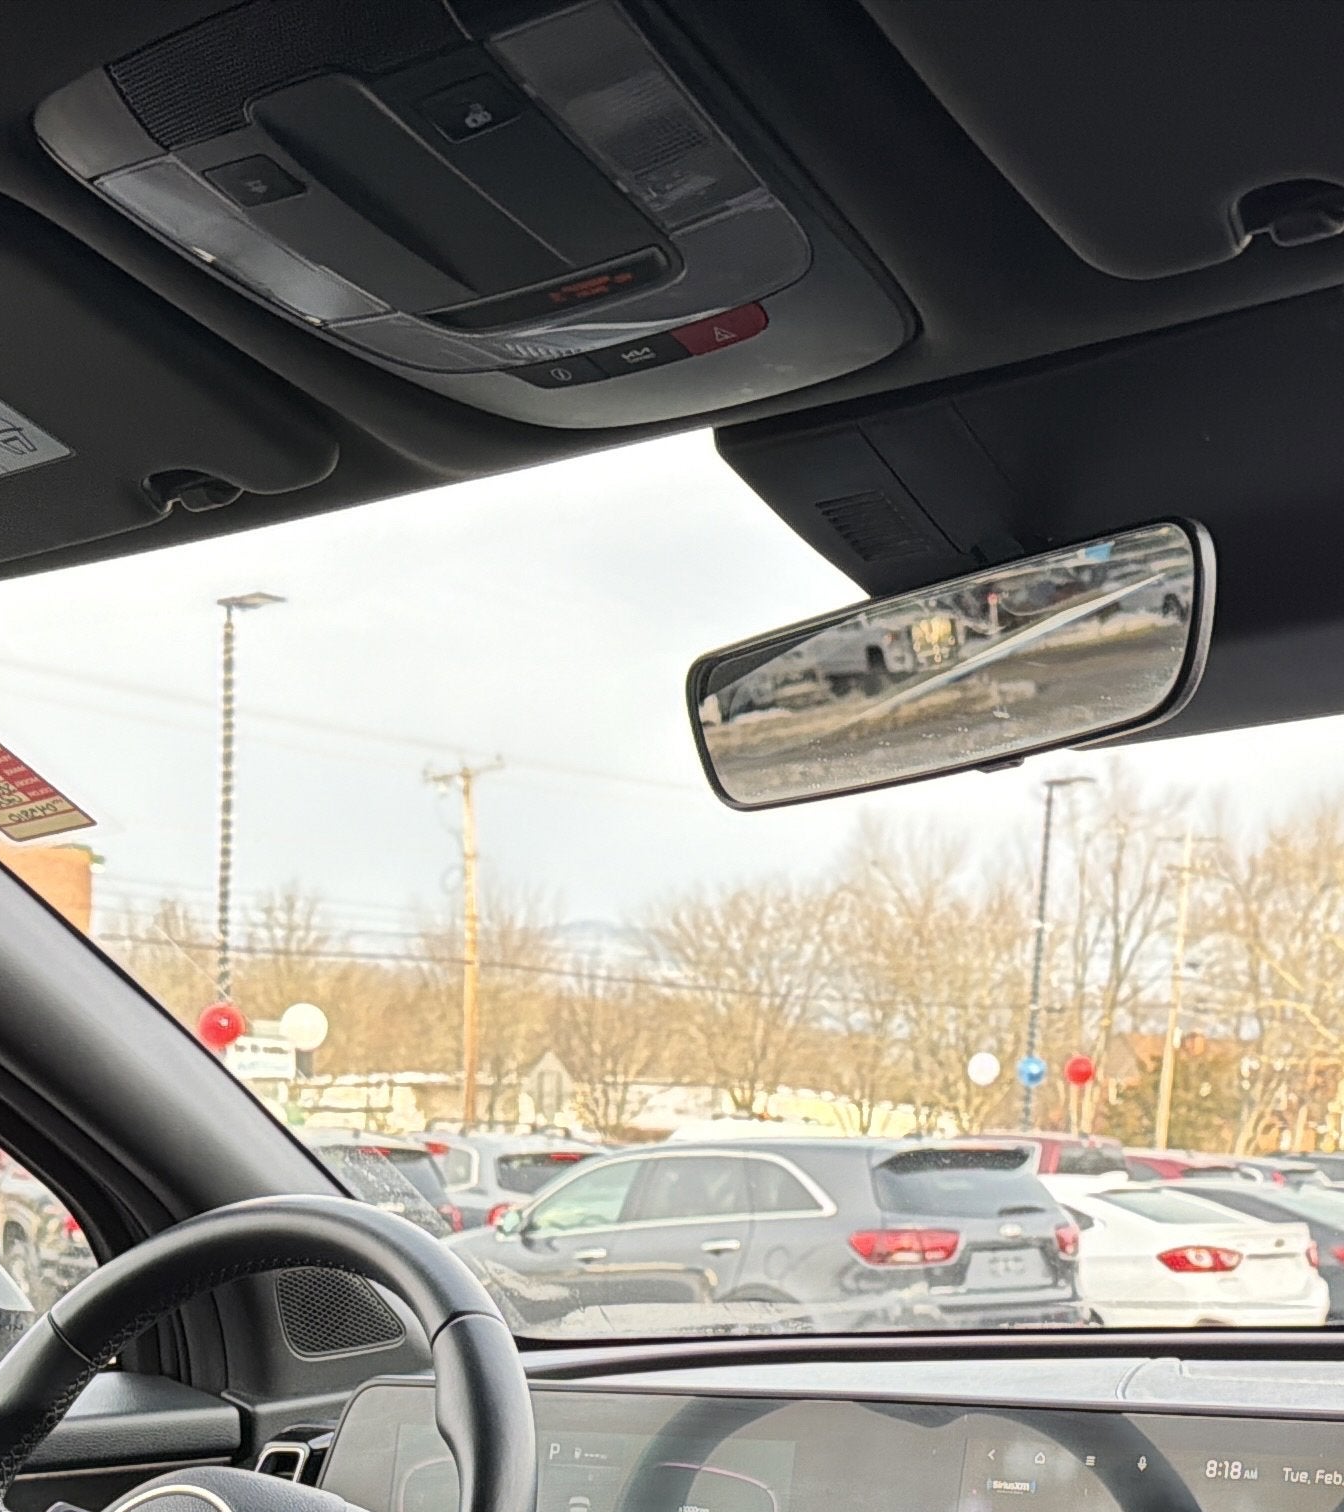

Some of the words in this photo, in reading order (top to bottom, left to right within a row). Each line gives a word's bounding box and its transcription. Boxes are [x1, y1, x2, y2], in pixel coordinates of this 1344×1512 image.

[549, 1443, 560, 1460] P
[1206, 1460, 1243, 1480] 8:18
[1243, 1470, 1258, 1480] AM
